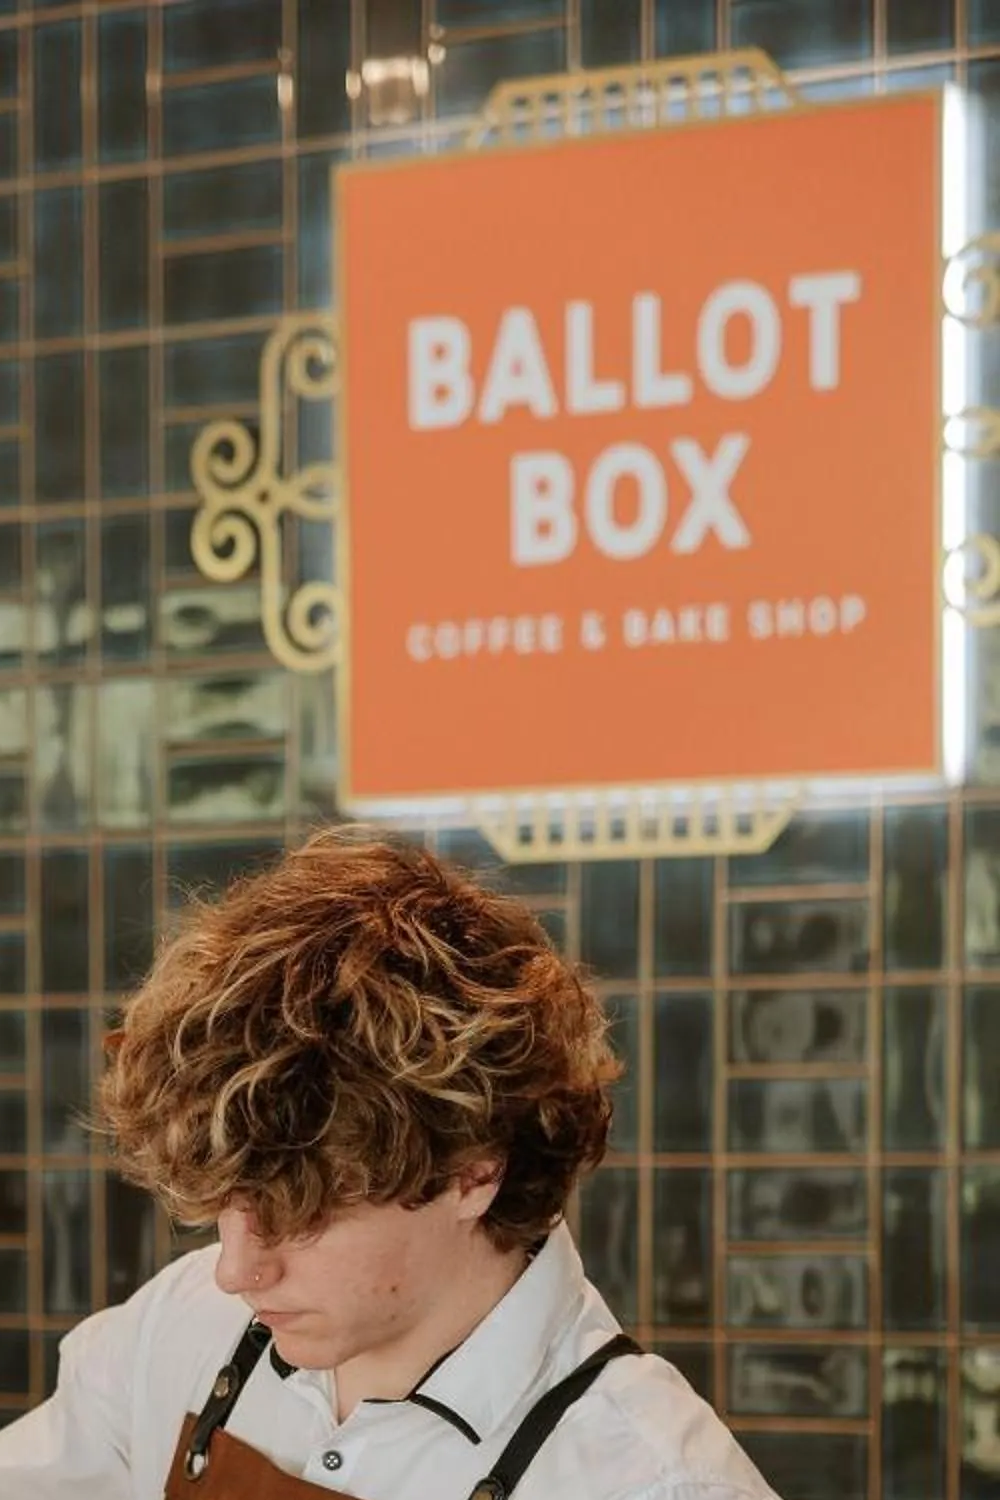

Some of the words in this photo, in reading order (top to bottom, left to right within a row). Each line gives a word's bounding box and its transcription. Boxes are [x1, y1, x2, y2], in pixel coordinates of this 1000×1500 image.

[406, 269, 863, 432] BALLOT
[509, 431, 752, 569] BOX
[405, 612, 564, 662] COFFEE
[579, 610, 607, 652] &
[622, 602, 730, 648] BAKE
[747, 594, 868, 640] SHOP
